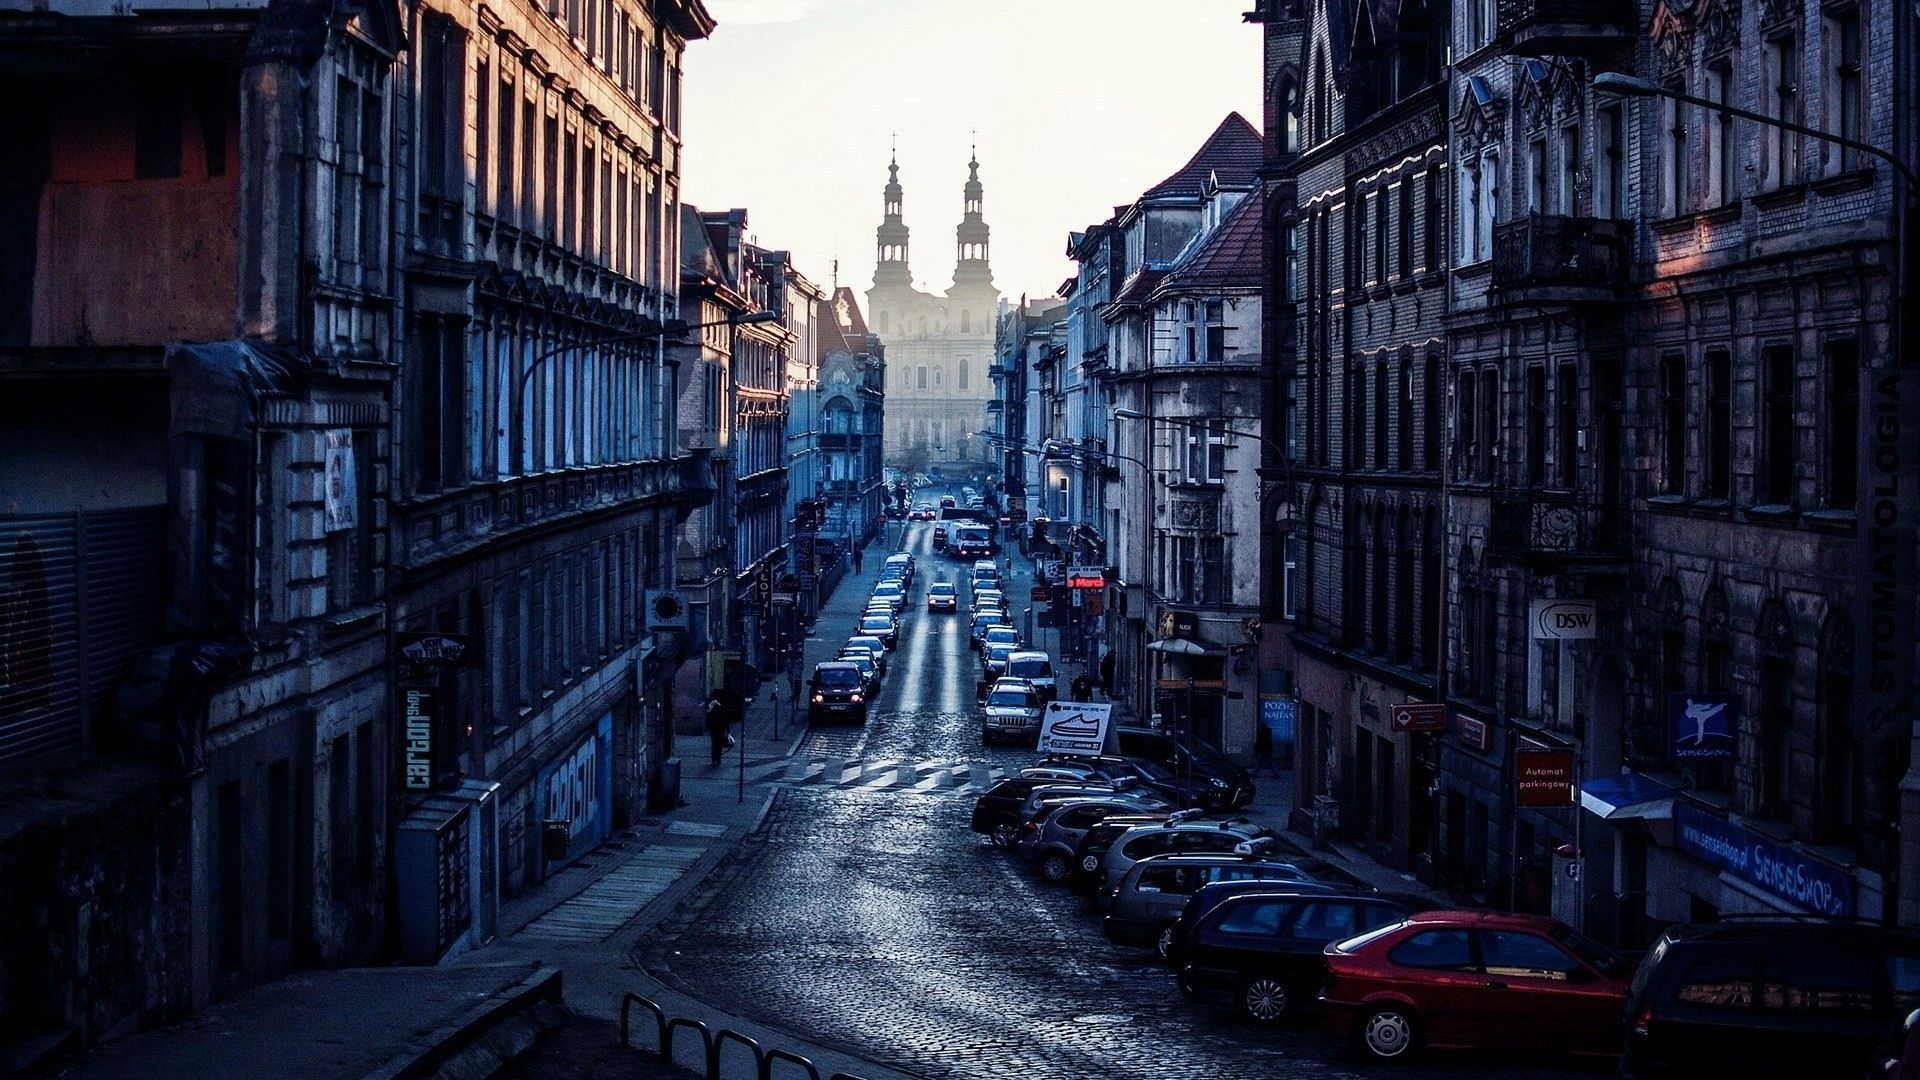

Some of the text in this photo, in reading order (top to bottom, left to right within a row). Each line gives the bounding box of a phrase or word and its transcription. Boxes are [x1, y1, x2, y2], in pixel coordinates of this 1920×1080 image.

[1871, 374, 1901, 694] STOMATOLOGIA
[1554, 613, 1592, 628] DSW
[1519, 780, 1569, 790] parkingowy
